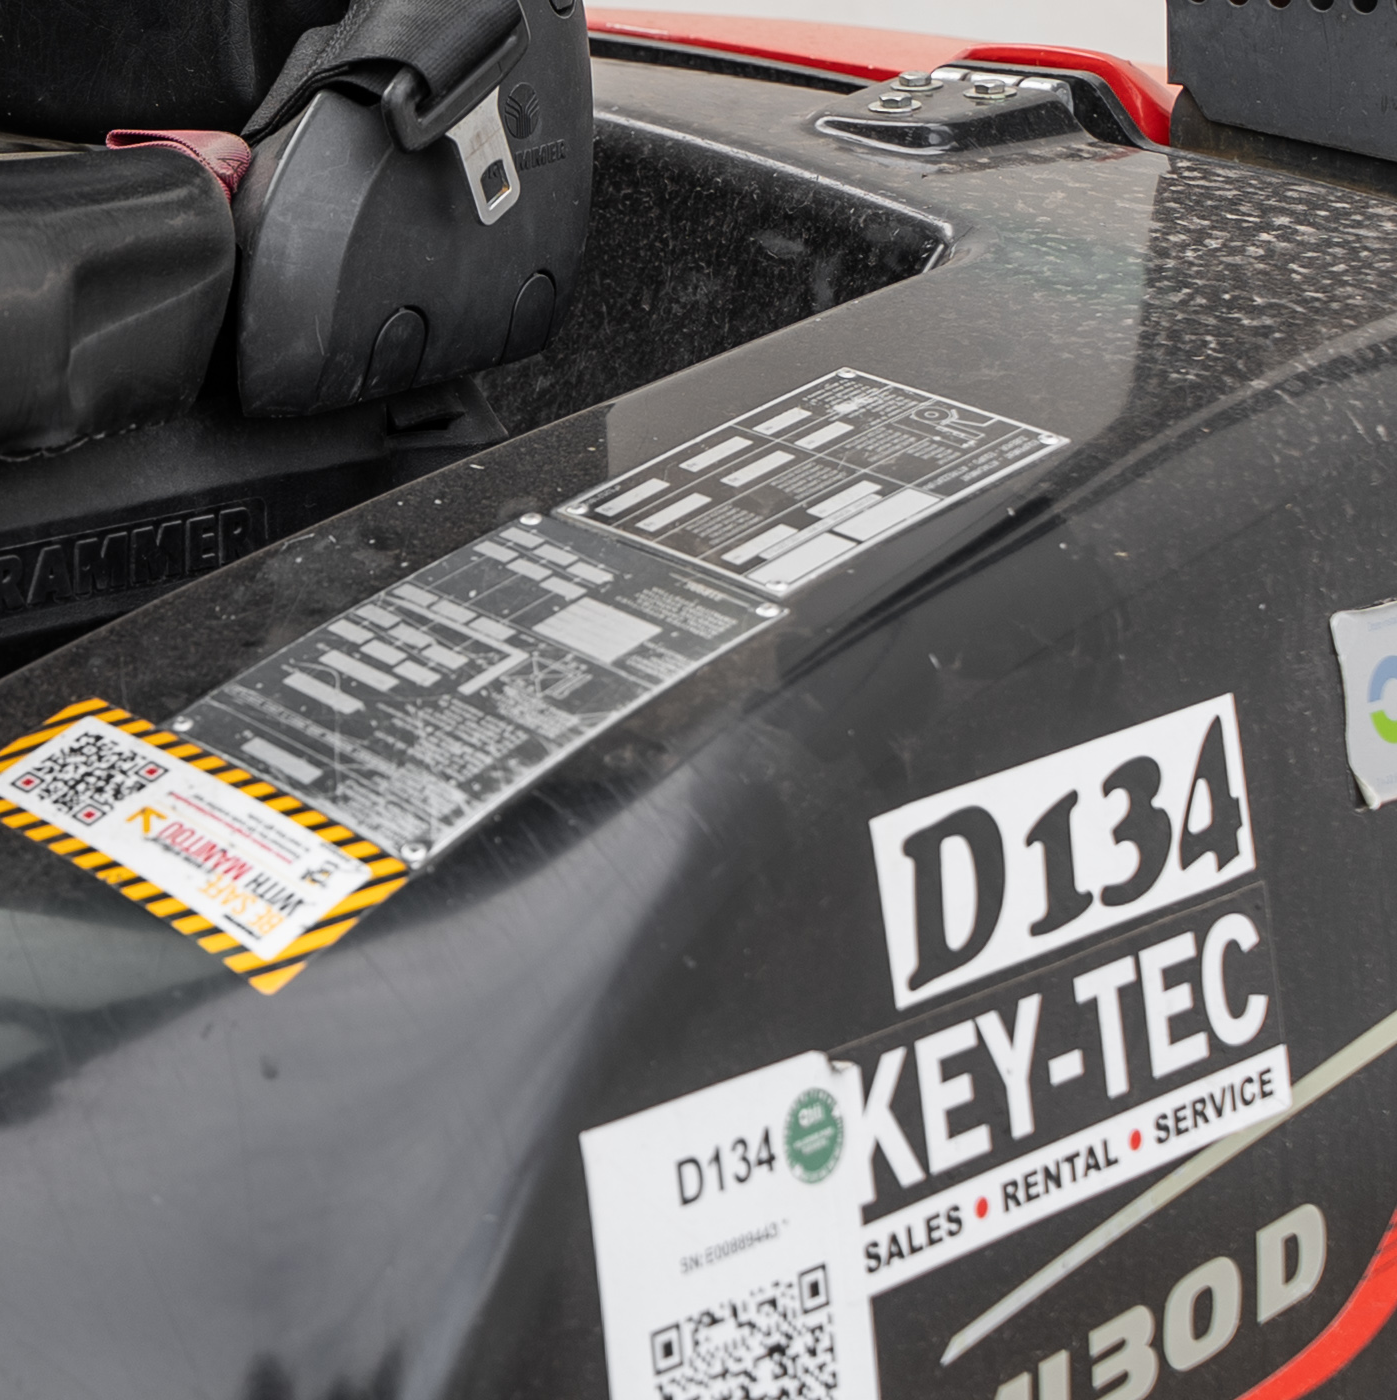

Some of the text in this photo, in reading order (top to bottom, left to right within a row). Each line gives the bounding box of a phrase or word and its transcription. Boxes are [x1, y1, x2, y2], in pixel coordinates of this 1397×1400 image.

[158, 821, 254, 882] MANITOU
[902, 713, 1244, 992] D134
[198, 873, 259, 916] SAFE
[245, 872, 305, 917] WITH
[247, 903, 286, 936] BE
[857, 912, 1269, 1206] KEY-TEC
[676, 1126, 776, 1206] D134
[863, 1066, 1275, 1274] SALES RENTAL SERVICE
